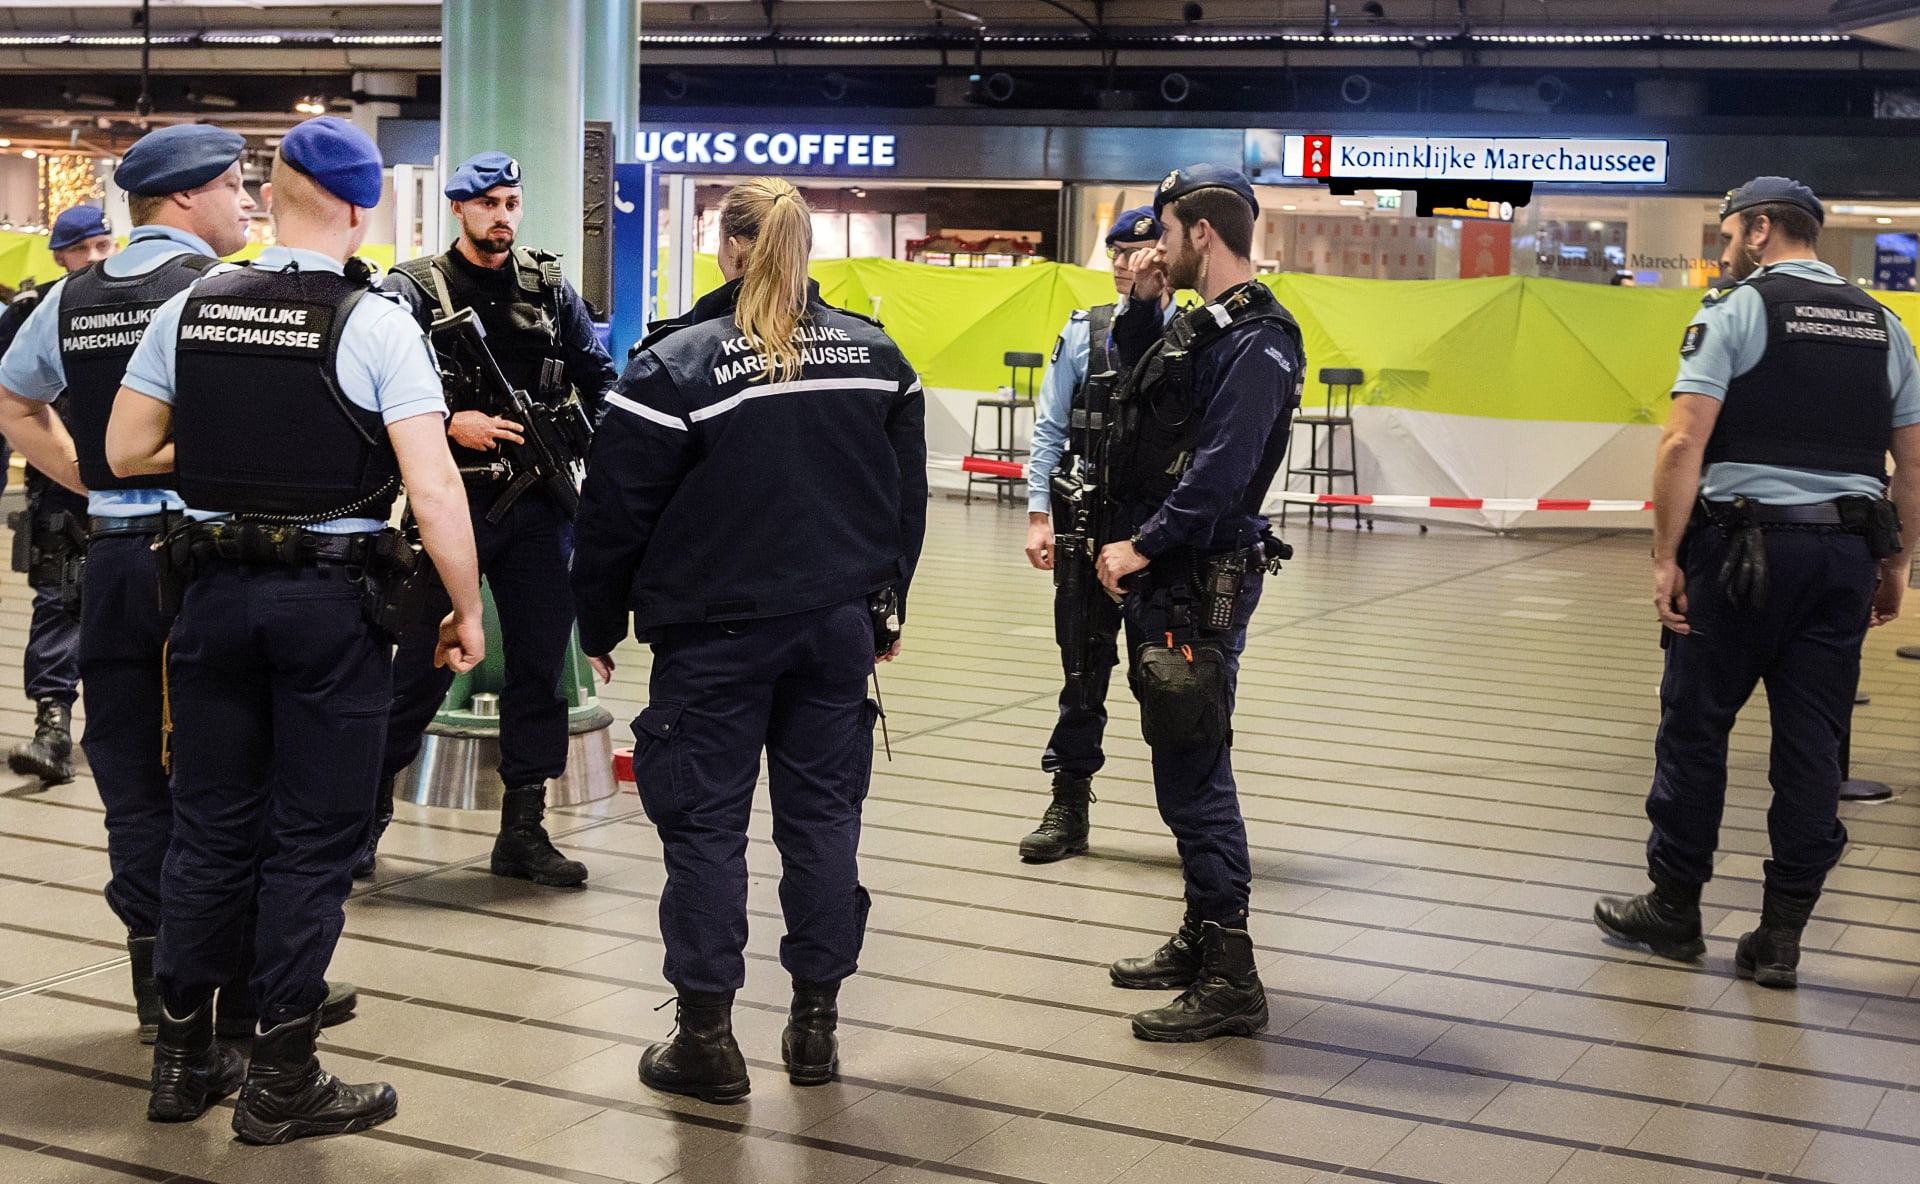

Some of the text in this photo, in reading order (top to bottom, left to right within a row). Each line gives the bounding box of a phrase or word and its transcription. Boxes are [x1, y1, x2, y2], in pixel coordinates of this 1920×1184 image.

[634, 131, 896, 167] UCKS COFFEE
[1341, 144, 1656, 175] Koninklijke Marechaussee
[198, 304, 308, 325] KONINKLIJKE
[181, 325, 321, 349] MARECHAUSSEE
[1785, 321, 1888, 342] MARECHAUSSEE
[713, 346, 871, 385] MARECAUSSEE
